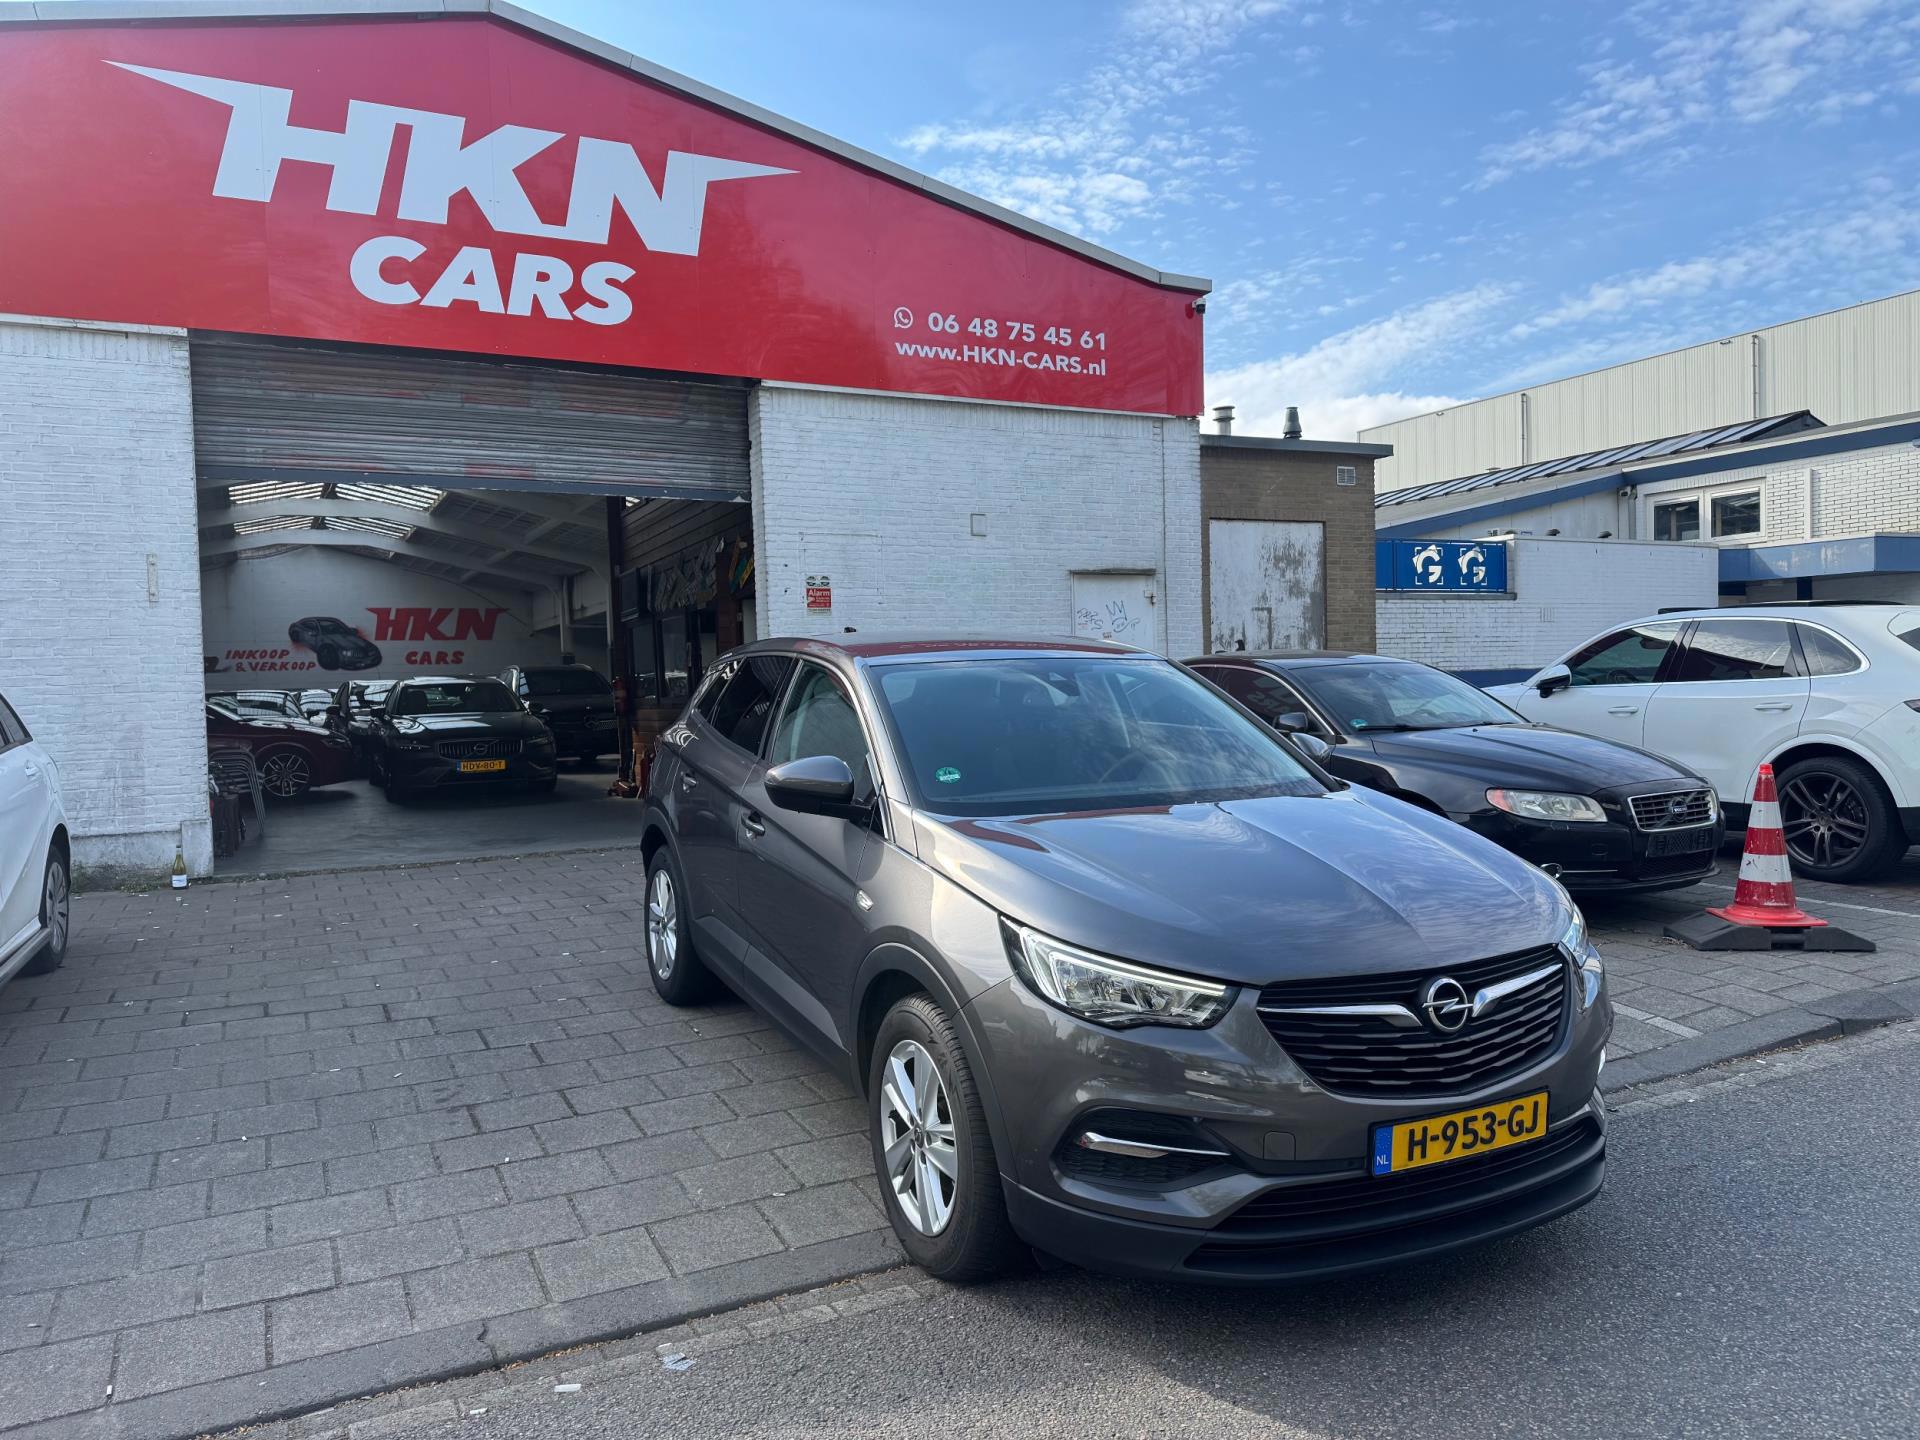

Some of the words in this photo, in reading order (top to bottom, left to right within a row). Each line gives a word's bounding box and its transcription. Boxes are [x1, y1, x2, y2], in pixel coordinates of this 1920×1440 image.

[100, 60, 801, 256] HKN
[349, 236, 636, 325] CARS
[927, 312, 960, 334] 06
[968, 318, 998, 338] 48
[1006, 321, 1036, 342] 75
[1044, 327, 1072, 347] 45
[1080, 331, 1105, 350] 61
[895, 342, 1106, 376] www.HKN-CARS.nl
[808, 589, 830, 597] Alarm
[365, 607, 511, 641] HKN
[225, 649, 290, 660] INKOOP
[249, 661, 317, 672] VERKOOP
[405, 650, 465, 665] CARS
[1407, 1100, 1539, 1162] H-953-GJ
[1376, 1154, 1389, 1166] NL
